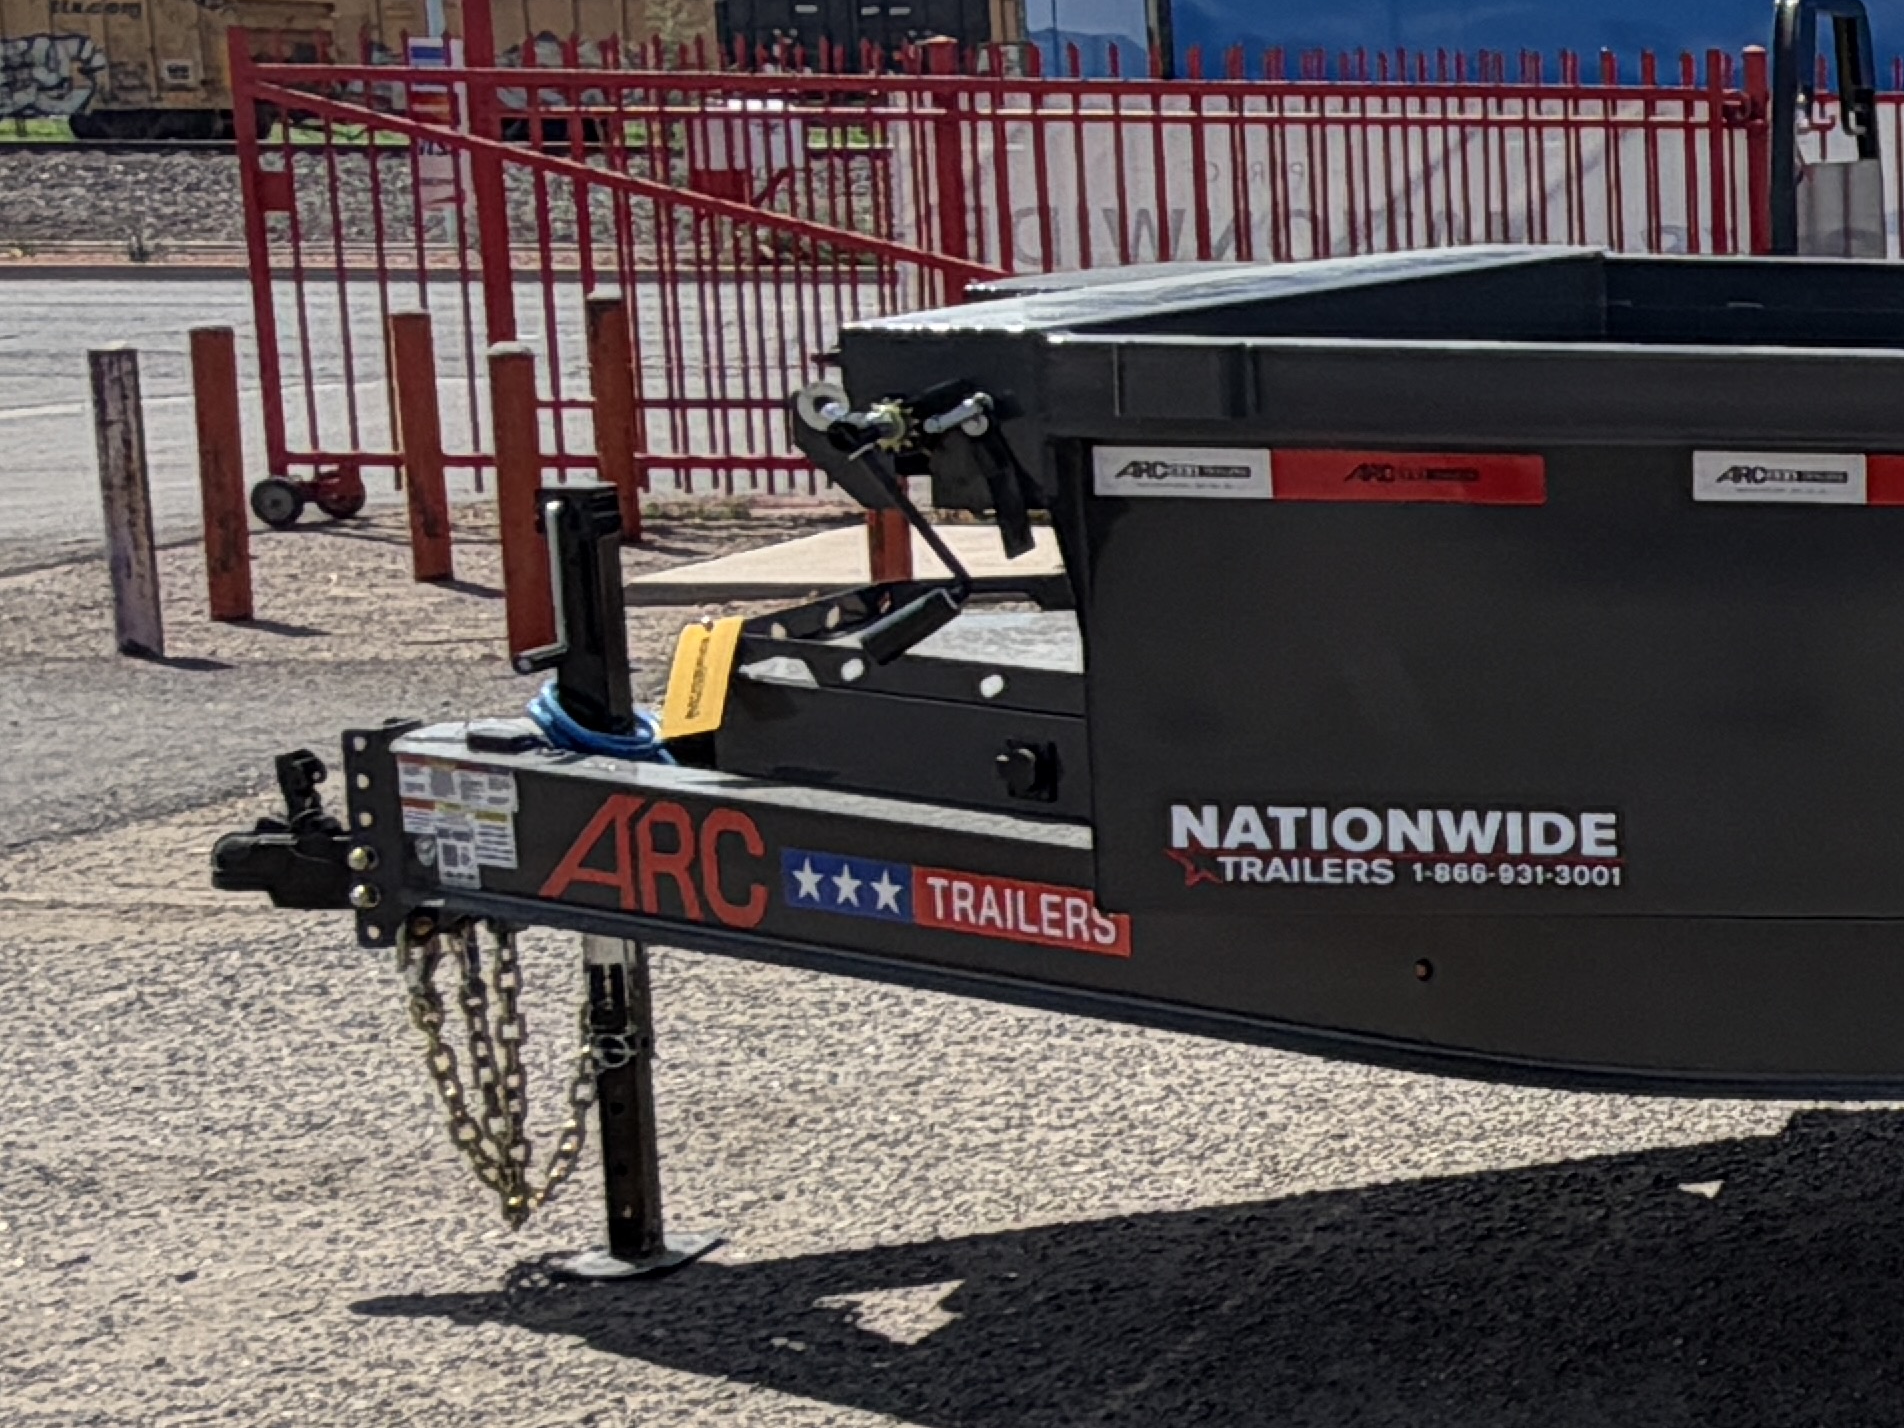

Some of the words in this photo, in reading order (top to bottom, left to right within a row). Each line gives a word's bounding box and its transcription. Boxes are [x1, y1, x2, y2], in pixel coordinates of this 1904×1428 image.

[1115, 461, 1168, 480] ARC
[1715, 464, 1767, 484] ARC
[1170, 804, 1618, 856] NATIONWIDE
[539, 794, 768, 929] ARC
[927, 875, 1118, 945] TRAILERS
[1217, 855, 1395, 885] TRAILERS
[1412, 862, 1622, 886] 1-866-931-3001
